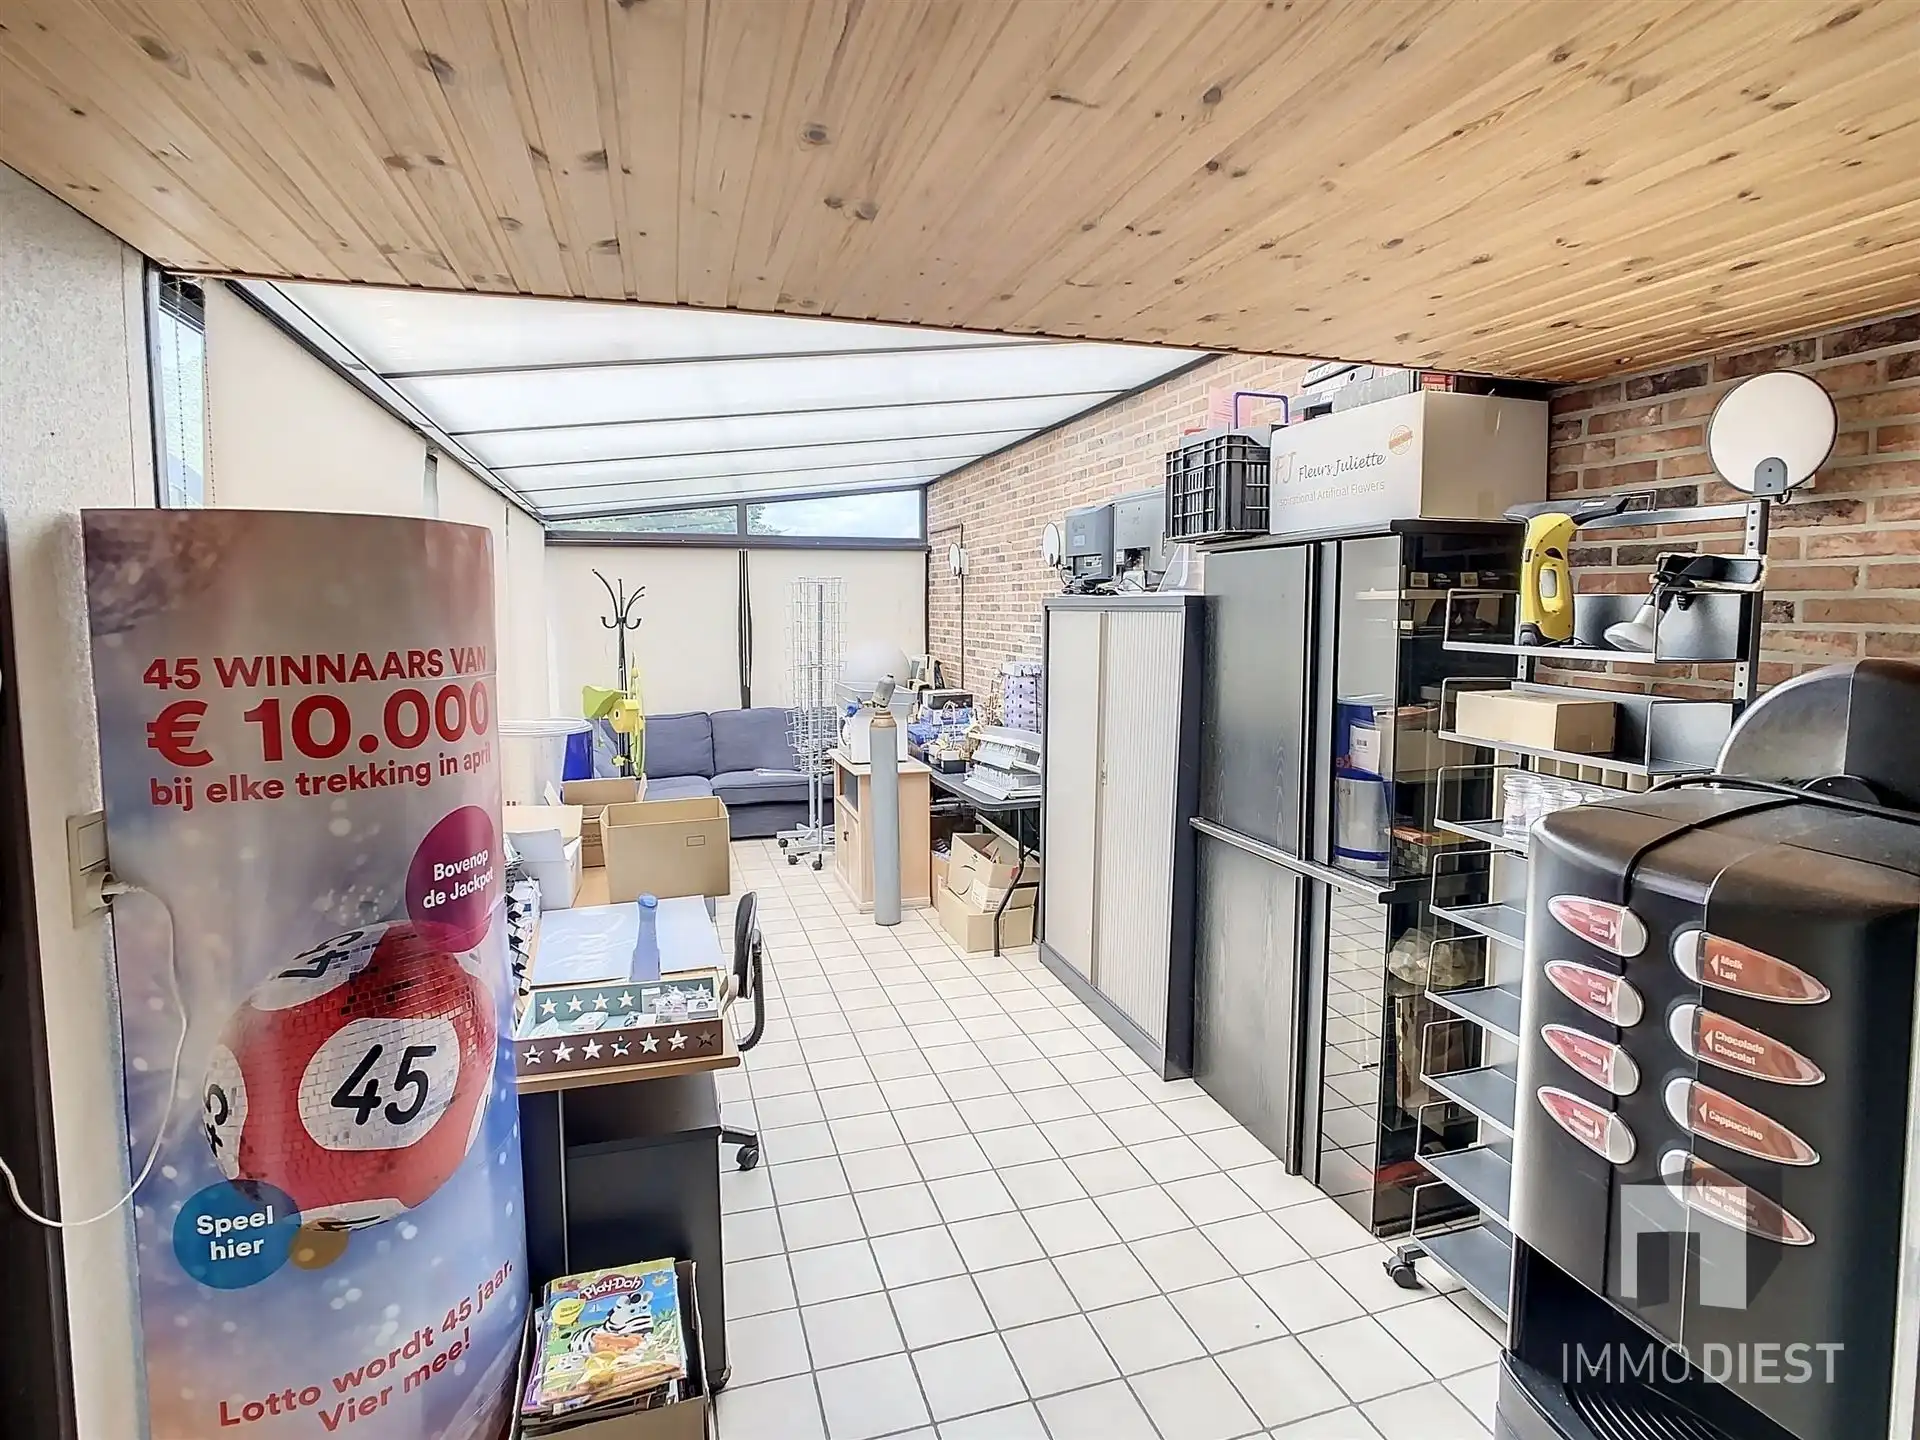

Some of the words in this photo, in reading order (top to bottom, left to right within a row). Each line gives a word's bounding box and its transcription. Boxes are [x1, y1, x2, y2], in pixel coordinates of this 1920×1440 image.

[1298, 464, 1333, 482] Fleurs
[1332, 452, 1387, 477] Juliette
[1317, 486, 1350, 501] Artificial
[1351, 479, 1386, 496] Flowers
[143, 656, 201, 690] 45
[213, 648, 444, 689] WINNAARS
[450, 646, 488, 675] VAN
[146, 699, 214, 768] €
[243, 681, 491, 762] 10.000
[150, 776, 194, 812] bij
[205, 773, 285, 804] elke
[295, 758, 431, 798] trekking
[439, 752, 459, 775] in
[463, 745, 493, 776] april
[433, 848, 490, 883] Bovenop
[423, 884, 447, 910] de
[449, 868, 494, 903] Jackpot
[1719, 967, 1738, 982] Lait
[1720, 955, 1744, 970] Melk
[1714, 1030, 1765, 1055] Chocolade
[1714, 1043, 1756, 1066] Chocolat
[330, 1043, 437, 1127] 45
[1708, 1110, 1764, 1141] Cappuccino
[196, 1205, 275, 1239] Speel
[210, 1239, 265, 1261] hier
[582, 1276, 641, 1300] Play-Doh
[219, 1384, 321, 1427] Lotto
[332, 1325, 434, 1394] wordt
[440, 1296, 473, 1334] 45
[476, 1259, 514, 1315] jaar.
[318, 1384, 394, 1434] Vier
[404, 1327, 473, 1394] mee!
